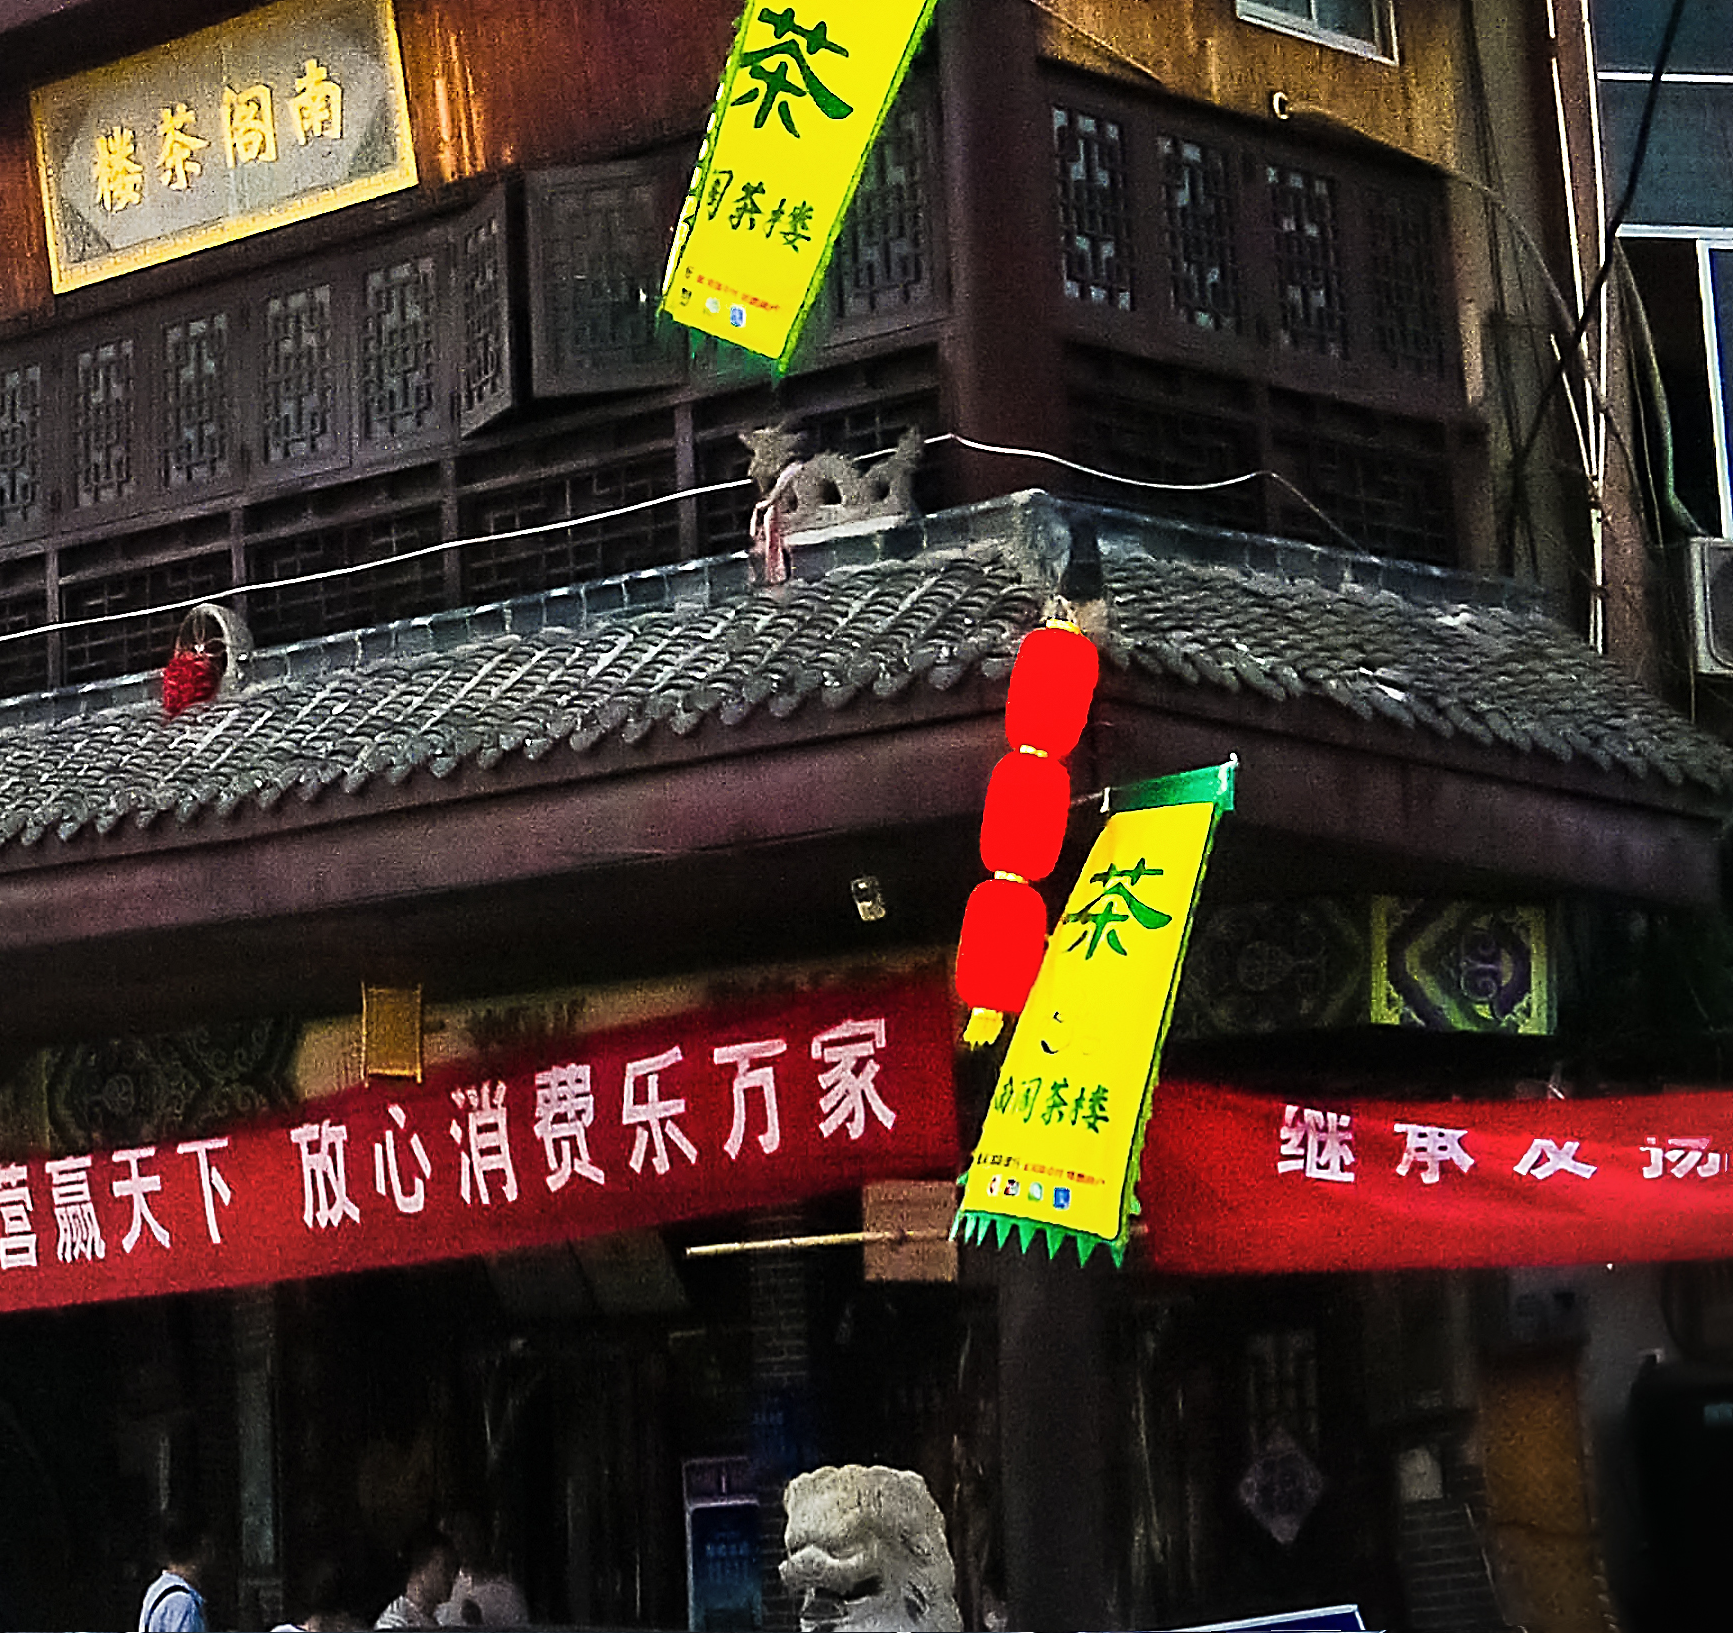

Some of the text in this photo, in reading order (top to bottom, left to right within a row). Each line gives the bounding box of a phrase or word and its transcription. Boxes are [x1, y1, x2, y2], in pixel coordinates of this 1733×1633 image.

[730, 6, 854, 138] 茶
[1061, 858, 1173, 962] 茶
[289, 1017, 899, 1230] 放心消费乐万家
